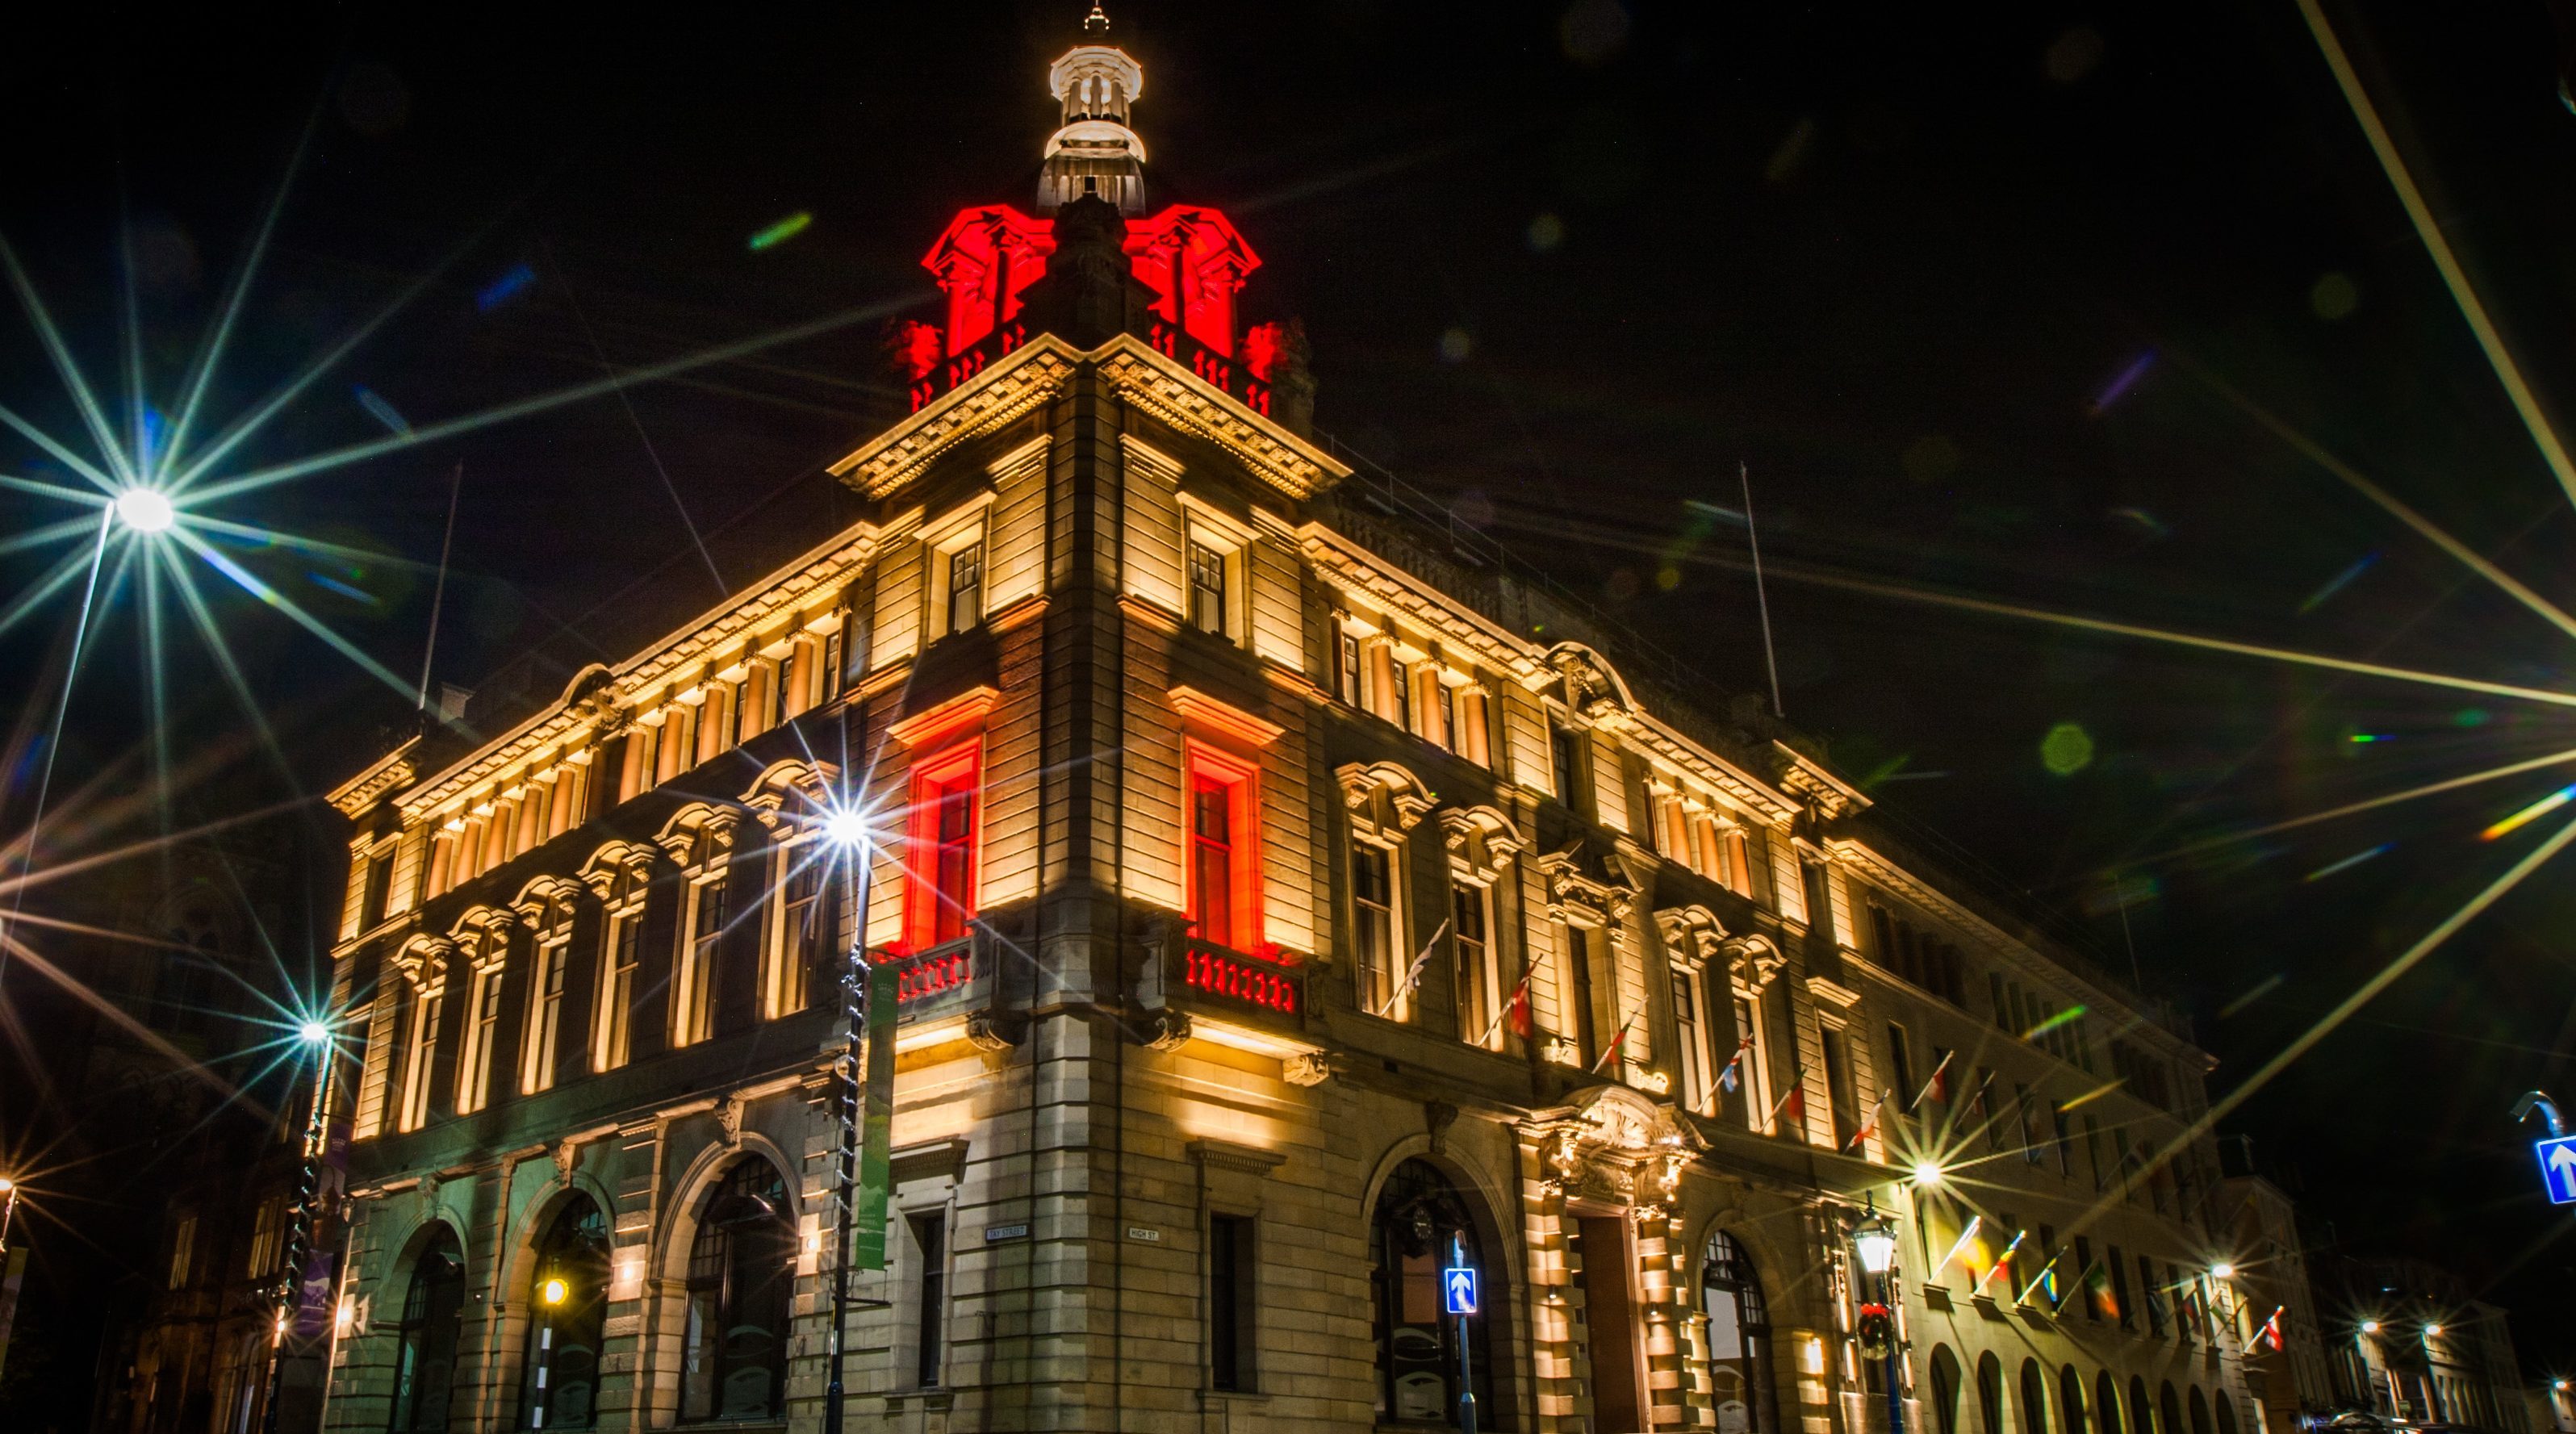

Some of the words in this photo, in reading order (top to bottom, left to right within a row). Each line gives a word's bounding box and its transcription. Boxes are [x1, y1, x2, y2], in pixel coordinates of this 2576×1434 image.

[989, 1230, 1001, 1238] TAY
[1002, 1227, 1025, 1236] STREET
[1131, 1229, 1146, 1238] HIGH
